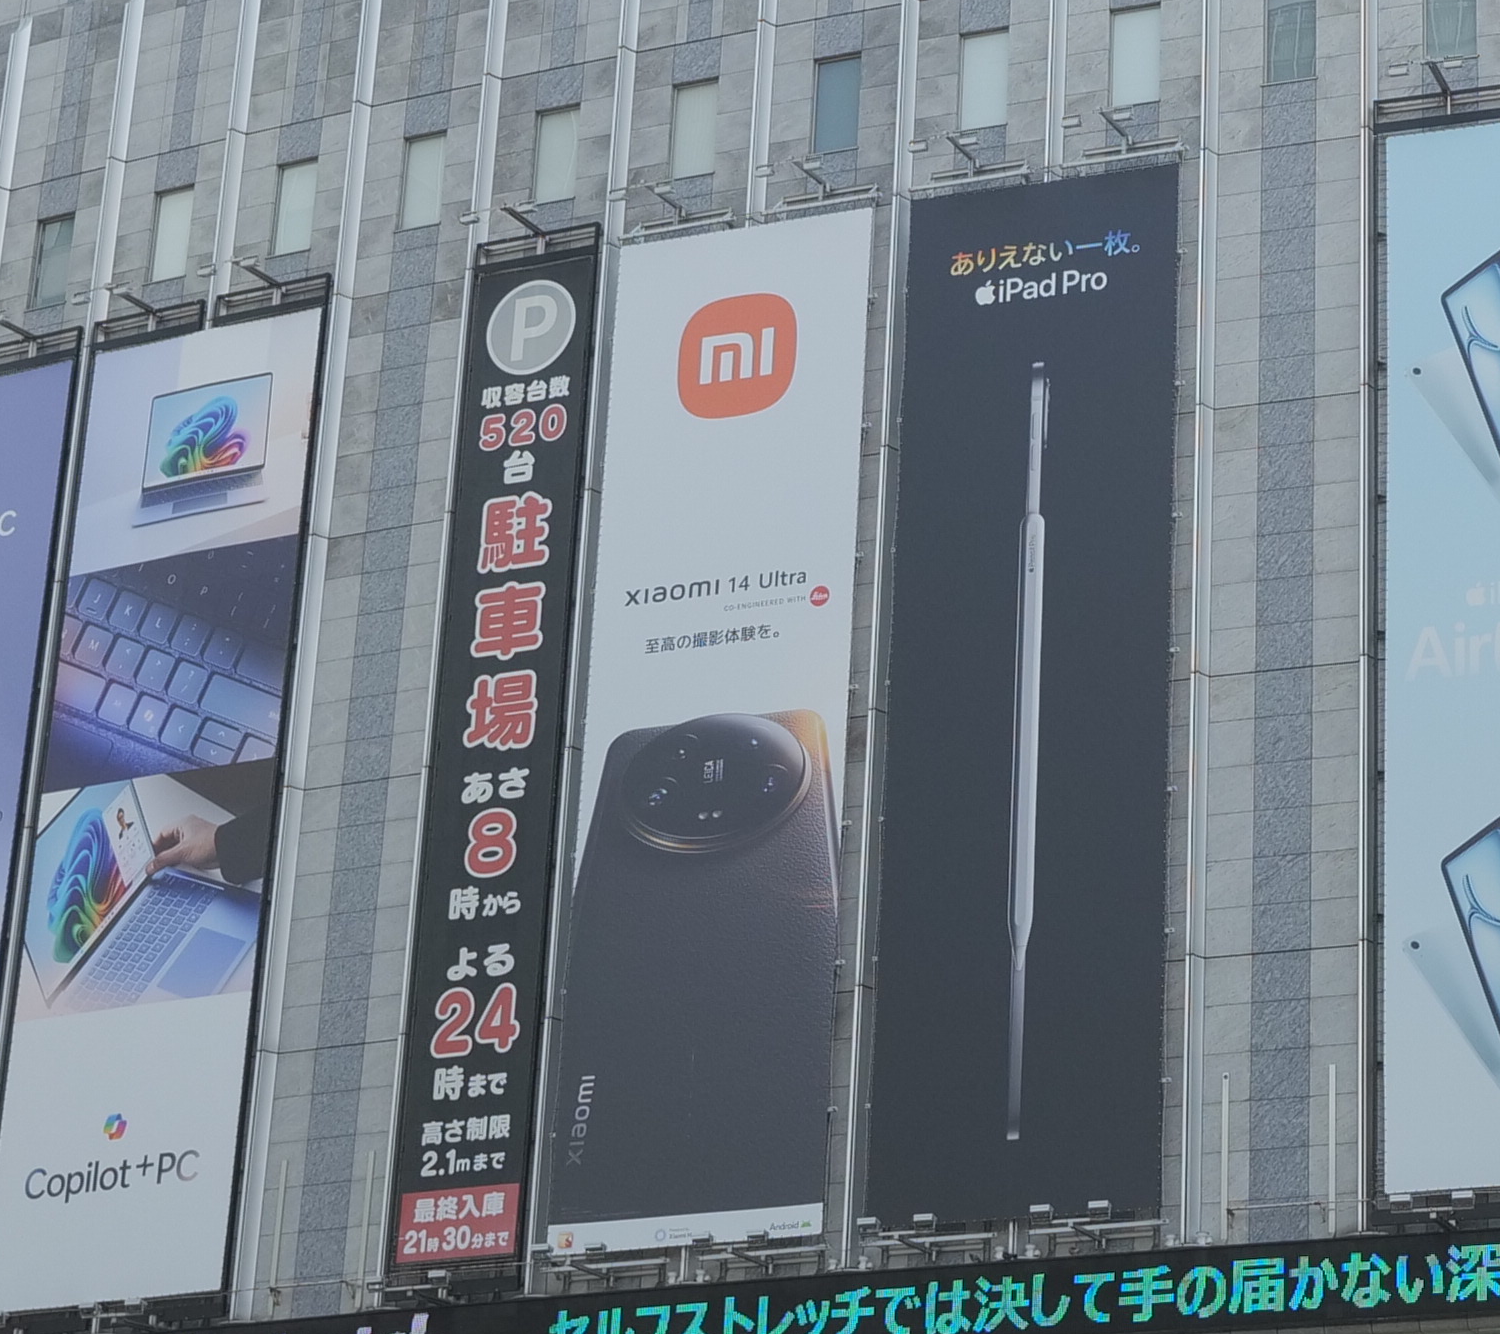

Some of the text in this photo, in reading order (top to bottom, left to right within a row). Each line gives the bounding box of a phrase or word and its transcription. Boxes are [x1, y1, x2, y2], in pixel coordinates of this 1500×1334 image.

[950, 229, 1141, 277] ありえない一枚。
[998, 269, 1108, 303] iPad Pro
[480, 375, 571, 410] 収容台数
[479, 403, 568, 451] 520
[728, 570, 807, 594] 14 Ultra
[462, 490, 553, 751] 駐車場
[644, 623, 780, 655] 至高の撮影体験を。
[460, 767, 531, 804] あさ
[447, 885, 522, 921] 時から
[446, 942, 516, 982] よる
[430, 982, 520, 1059] 24
[432, 1067, 508, 1101] 時まで
[421, 1114, 511, 1146] 高さ制限
[413, 1191, 505, 1223] 最終入庫
[769, 1219, 799, 1232] Android
